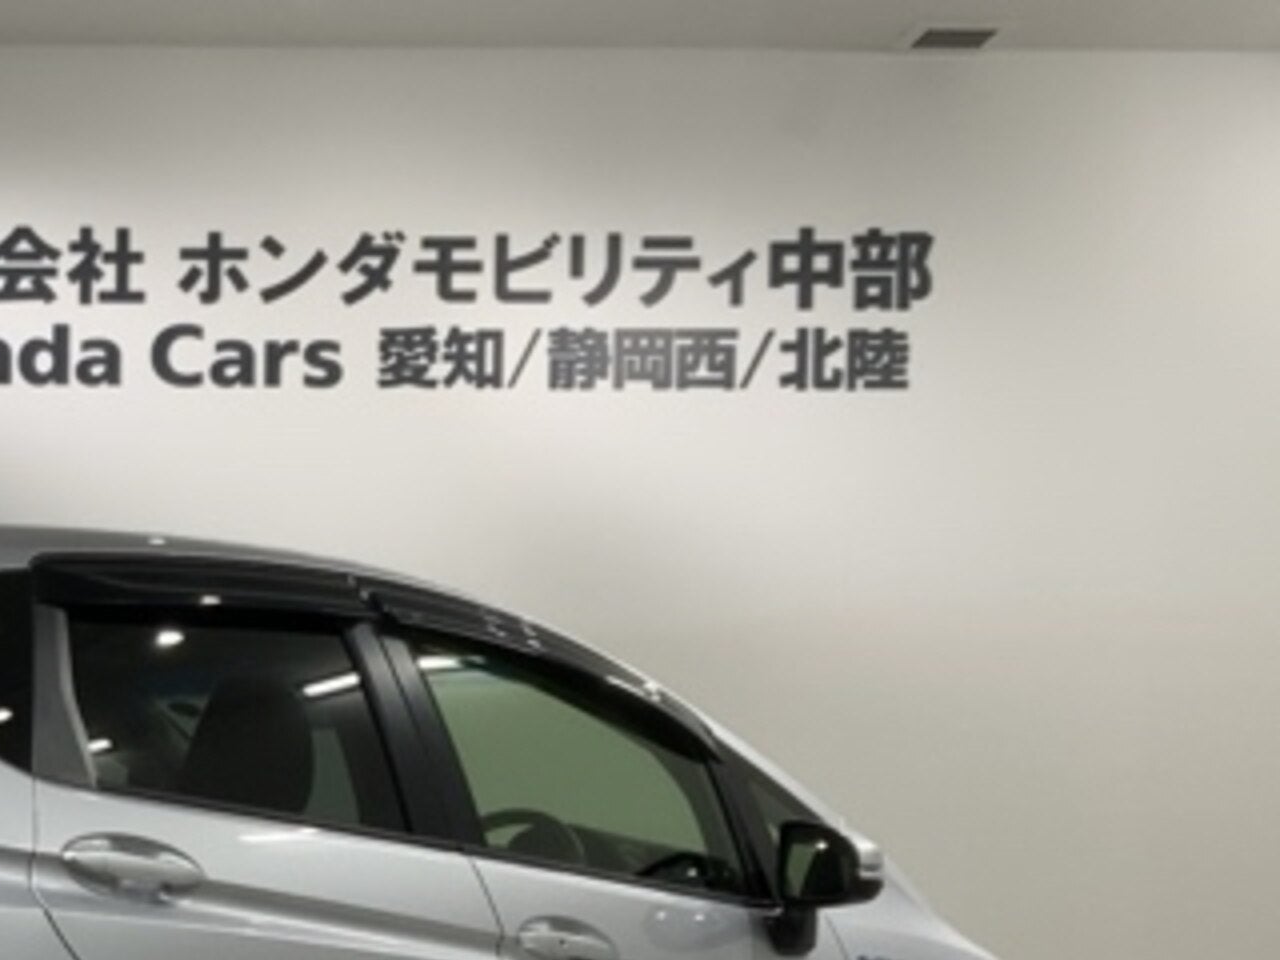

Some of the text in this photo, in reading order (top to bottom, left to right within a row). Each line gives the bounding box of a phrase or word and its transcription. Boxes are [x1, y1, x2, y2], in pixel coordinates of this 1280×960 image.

[176, 226, 935, 312] ホンダモビリティ中部
[149, 322, 344, 388] Cars
[376, 325, 911, 391] 愛知/静岡西/北陸
